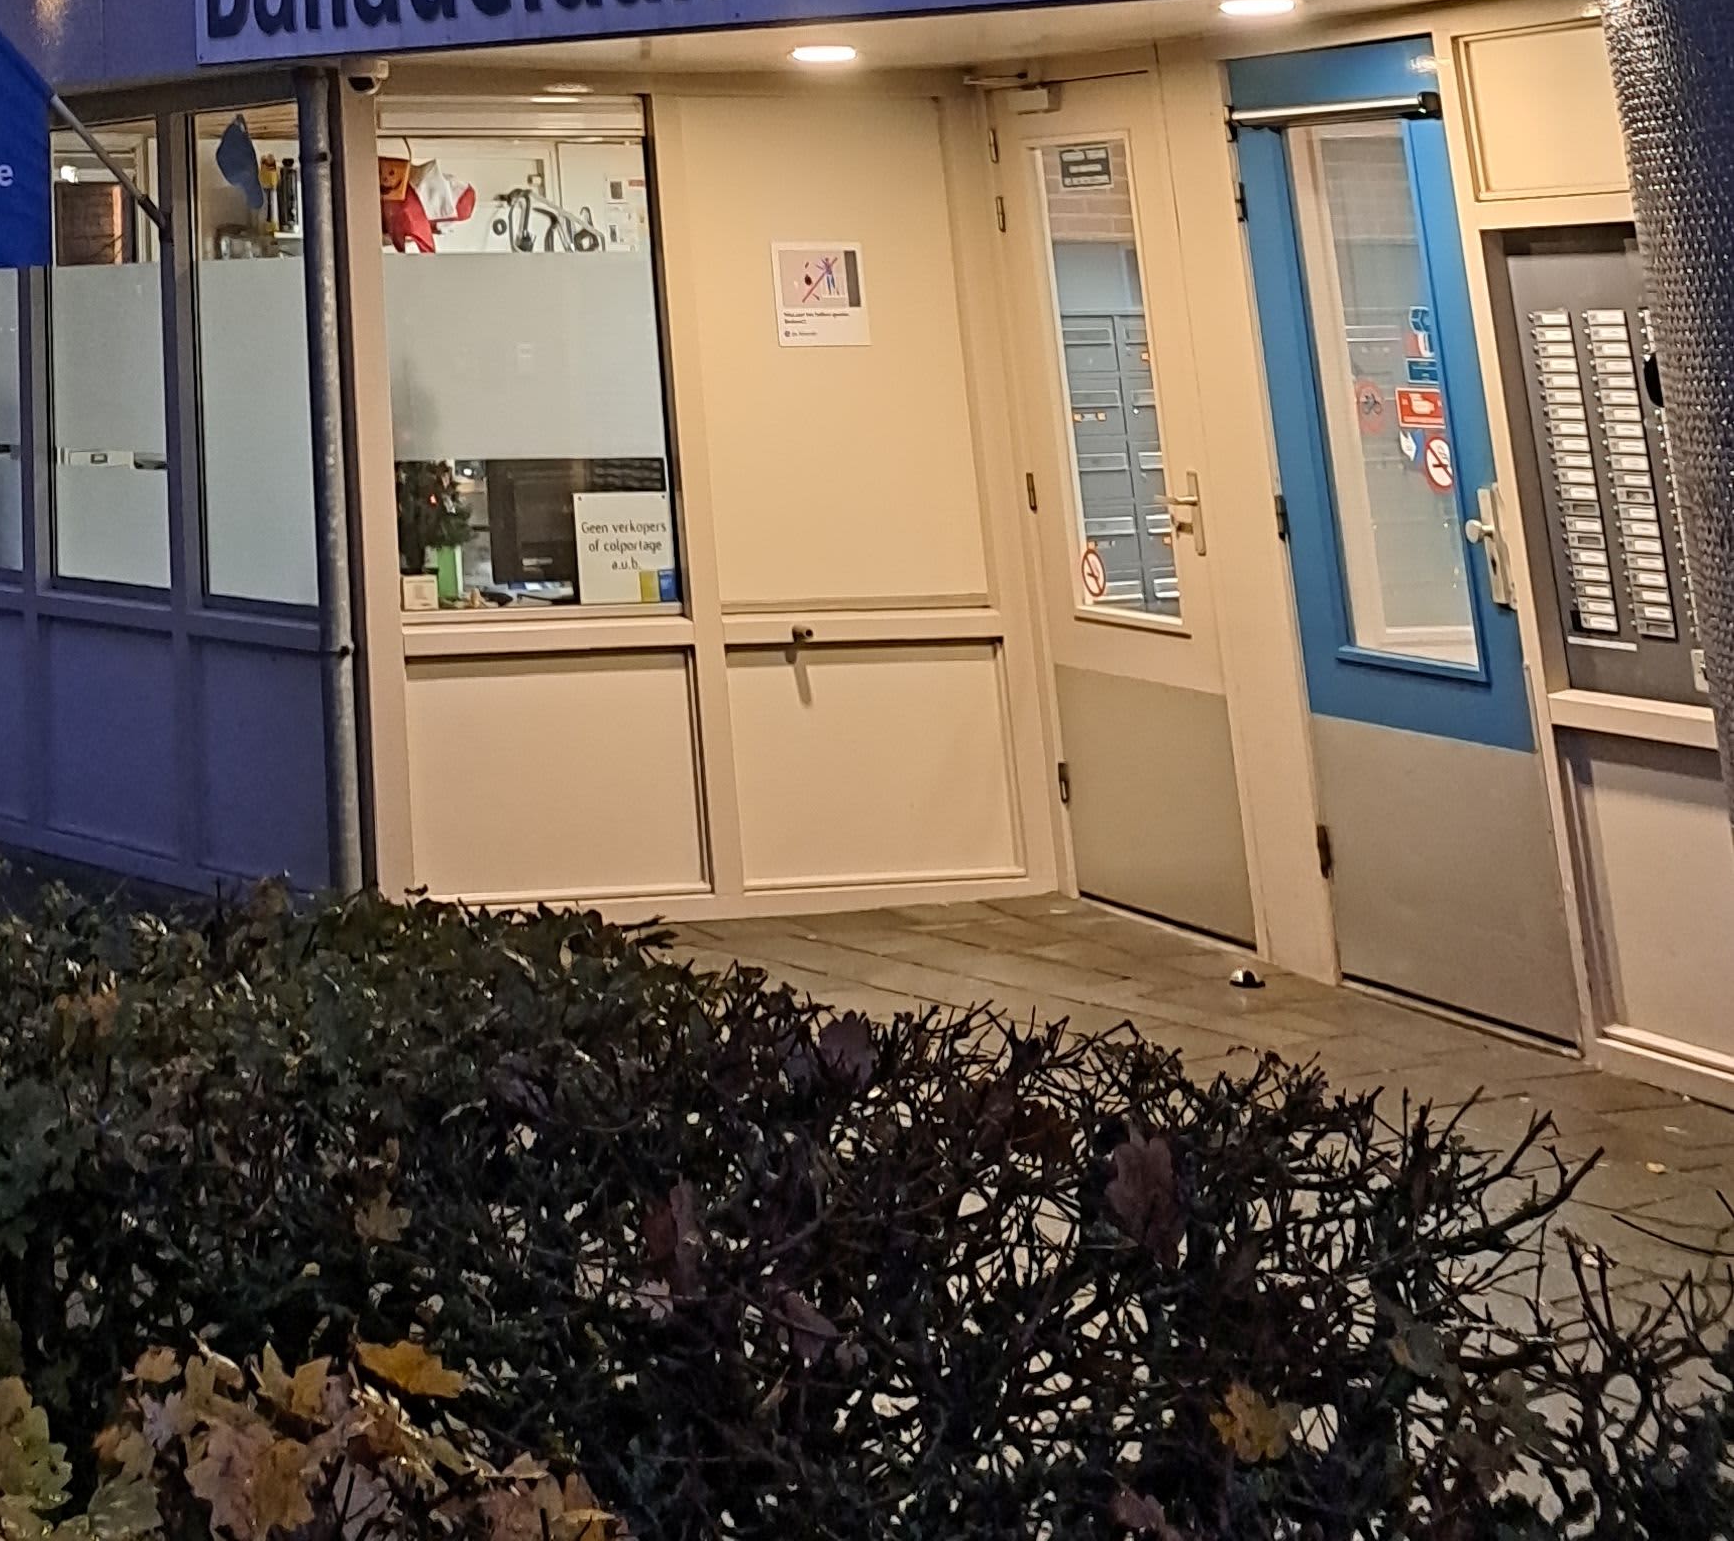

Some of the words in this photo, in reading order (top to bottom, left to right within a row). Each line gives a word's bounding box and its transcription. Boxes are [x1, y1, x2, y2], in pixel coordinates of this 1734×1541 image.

[581, 521, 608, 534] Geen
[612, 519, 667, 535] verkopers
[588, 538, 600, 552] of
[603, 538, 662, 554] colportage
[611, 556, 641, 570] a.u.b.
